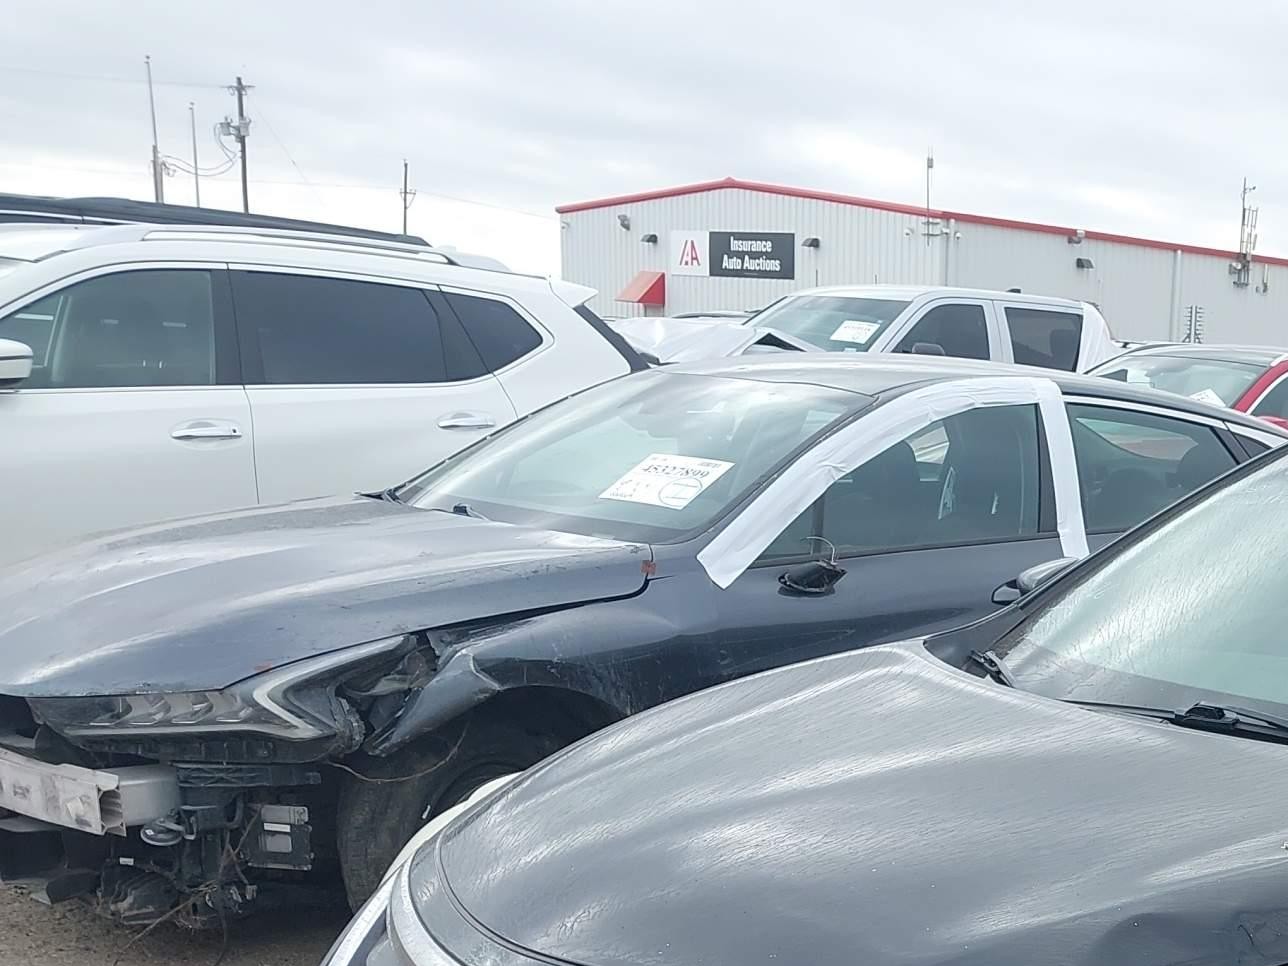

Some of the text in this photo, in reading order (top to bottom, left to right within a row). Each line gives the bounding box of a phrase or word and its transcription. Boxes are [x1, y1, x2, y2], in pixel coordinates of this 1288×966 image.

[730, 236, 772, 252] Insurance
[722, 254, 781, 271] Auto Auctions
